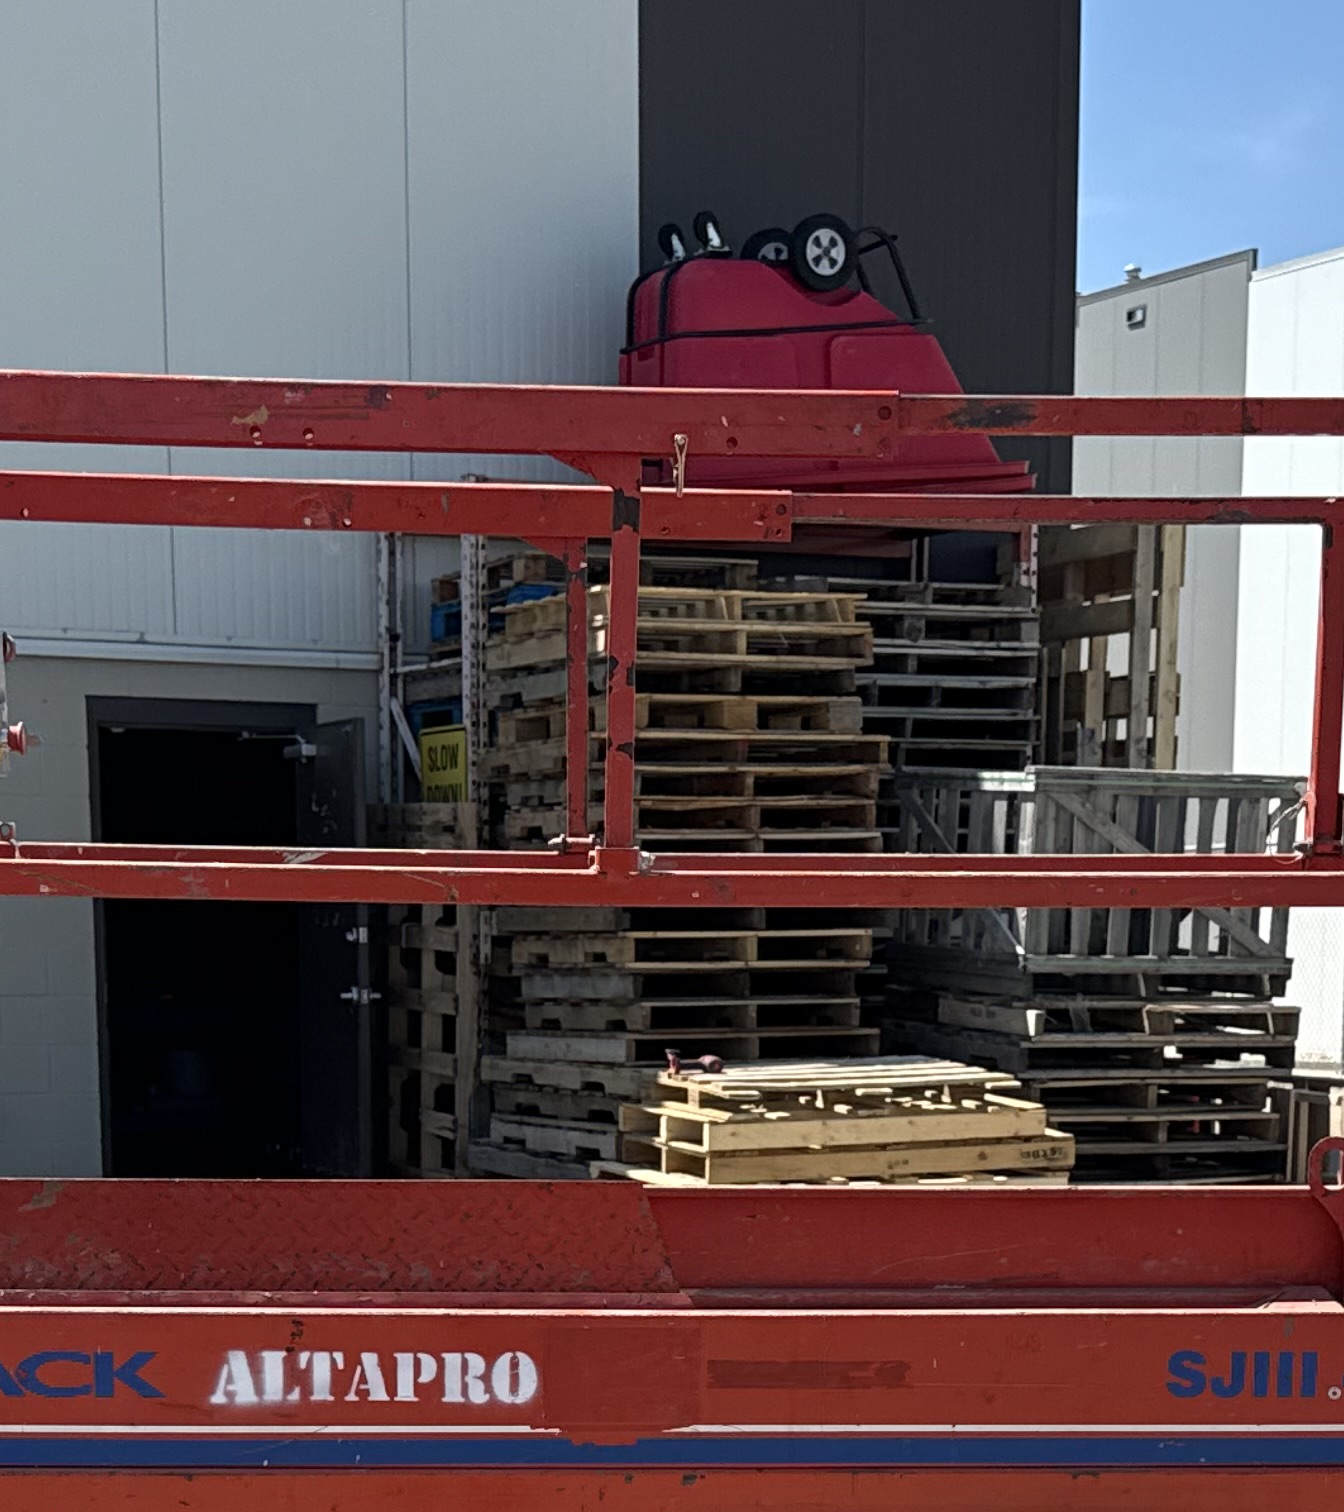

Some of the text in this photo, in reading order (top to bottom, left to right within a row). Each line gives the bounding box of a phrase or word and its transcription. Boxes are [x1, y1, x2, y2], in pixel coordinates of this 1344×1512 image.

[427, 743, 459, 772] SLOW
[211, 1350, 539, 1404] ALTAPRO
[1166, 1350, 1318, 1398] SJIII
